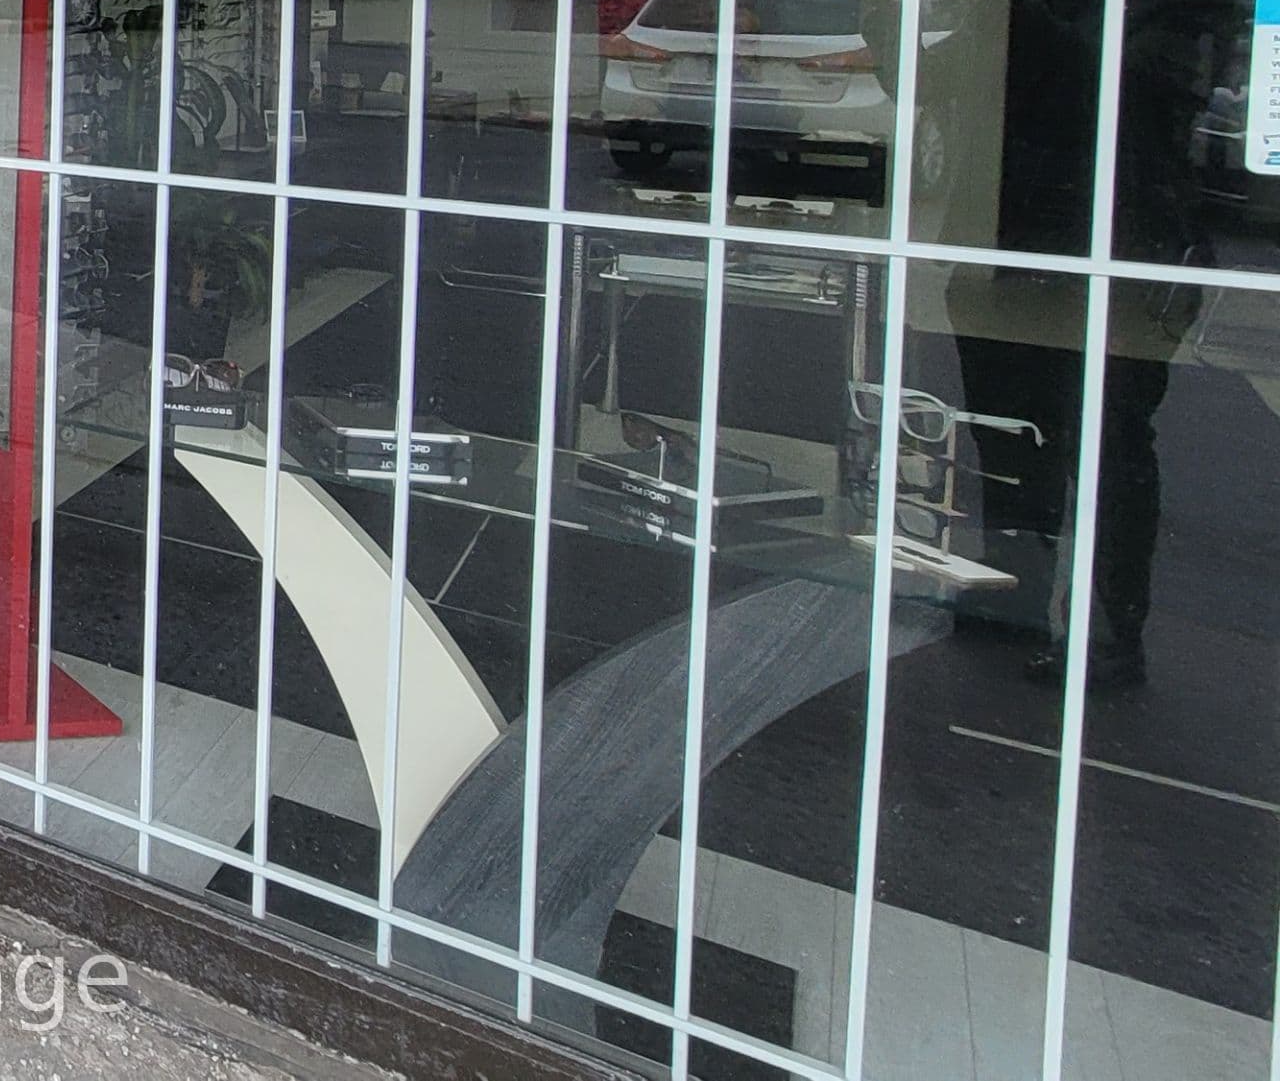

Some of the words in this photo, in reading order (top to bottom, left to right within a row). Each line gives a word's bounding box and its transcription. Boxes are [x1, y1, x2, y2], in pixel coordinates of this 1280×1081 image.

[164, 403, 191, 412] MARC
[193, 404, 233, 415] JACOBS
[621, 481, 643, 496] TOM
[643, 489, 672, 504] FORD
